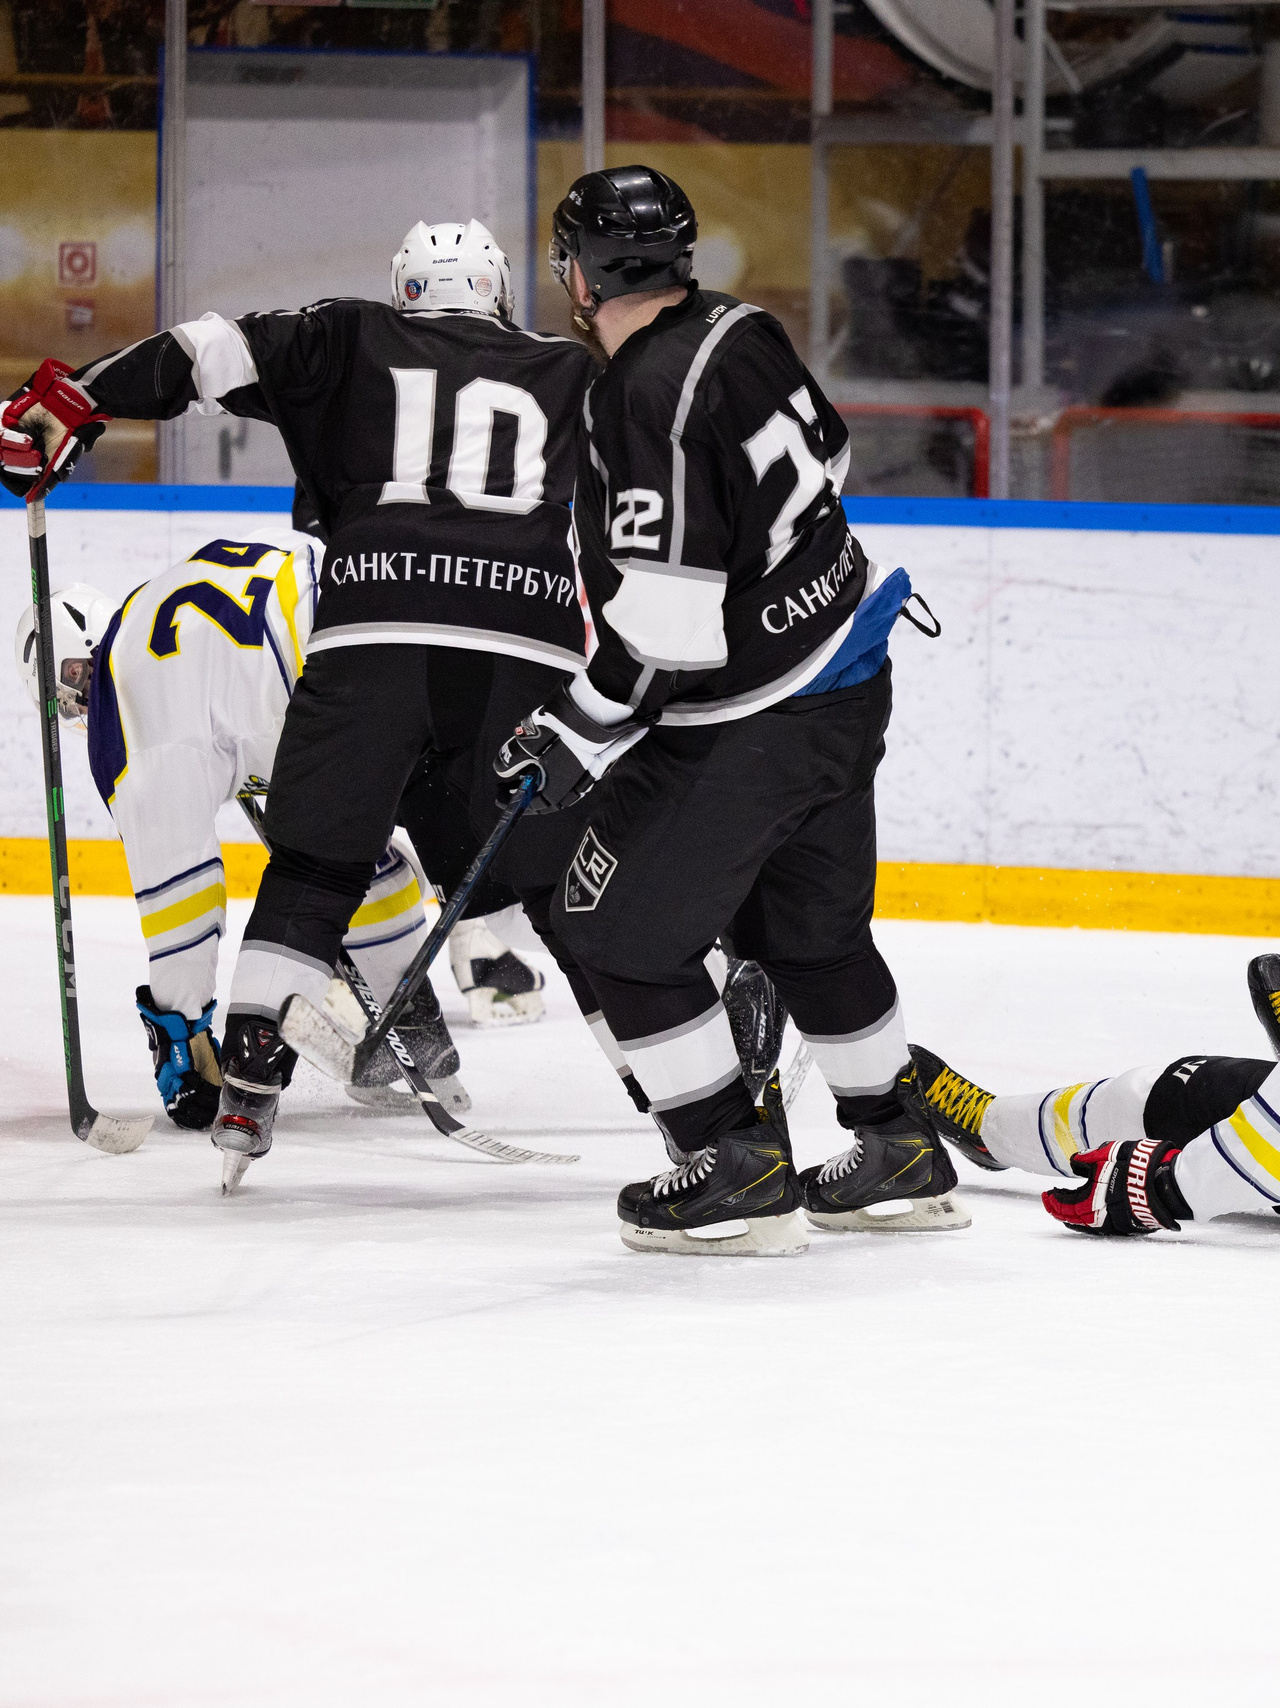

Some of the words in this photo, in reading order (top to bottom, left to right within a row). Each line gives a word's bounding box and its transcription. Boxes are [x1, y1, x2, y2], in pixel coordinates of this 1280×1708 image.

[705, 304, 728, 324] LUTCH
[56, 389, 85, 411] BAUER
[376, 366, 549, 516] 10
[344, 964, 415, 1068] SHER-OOD
